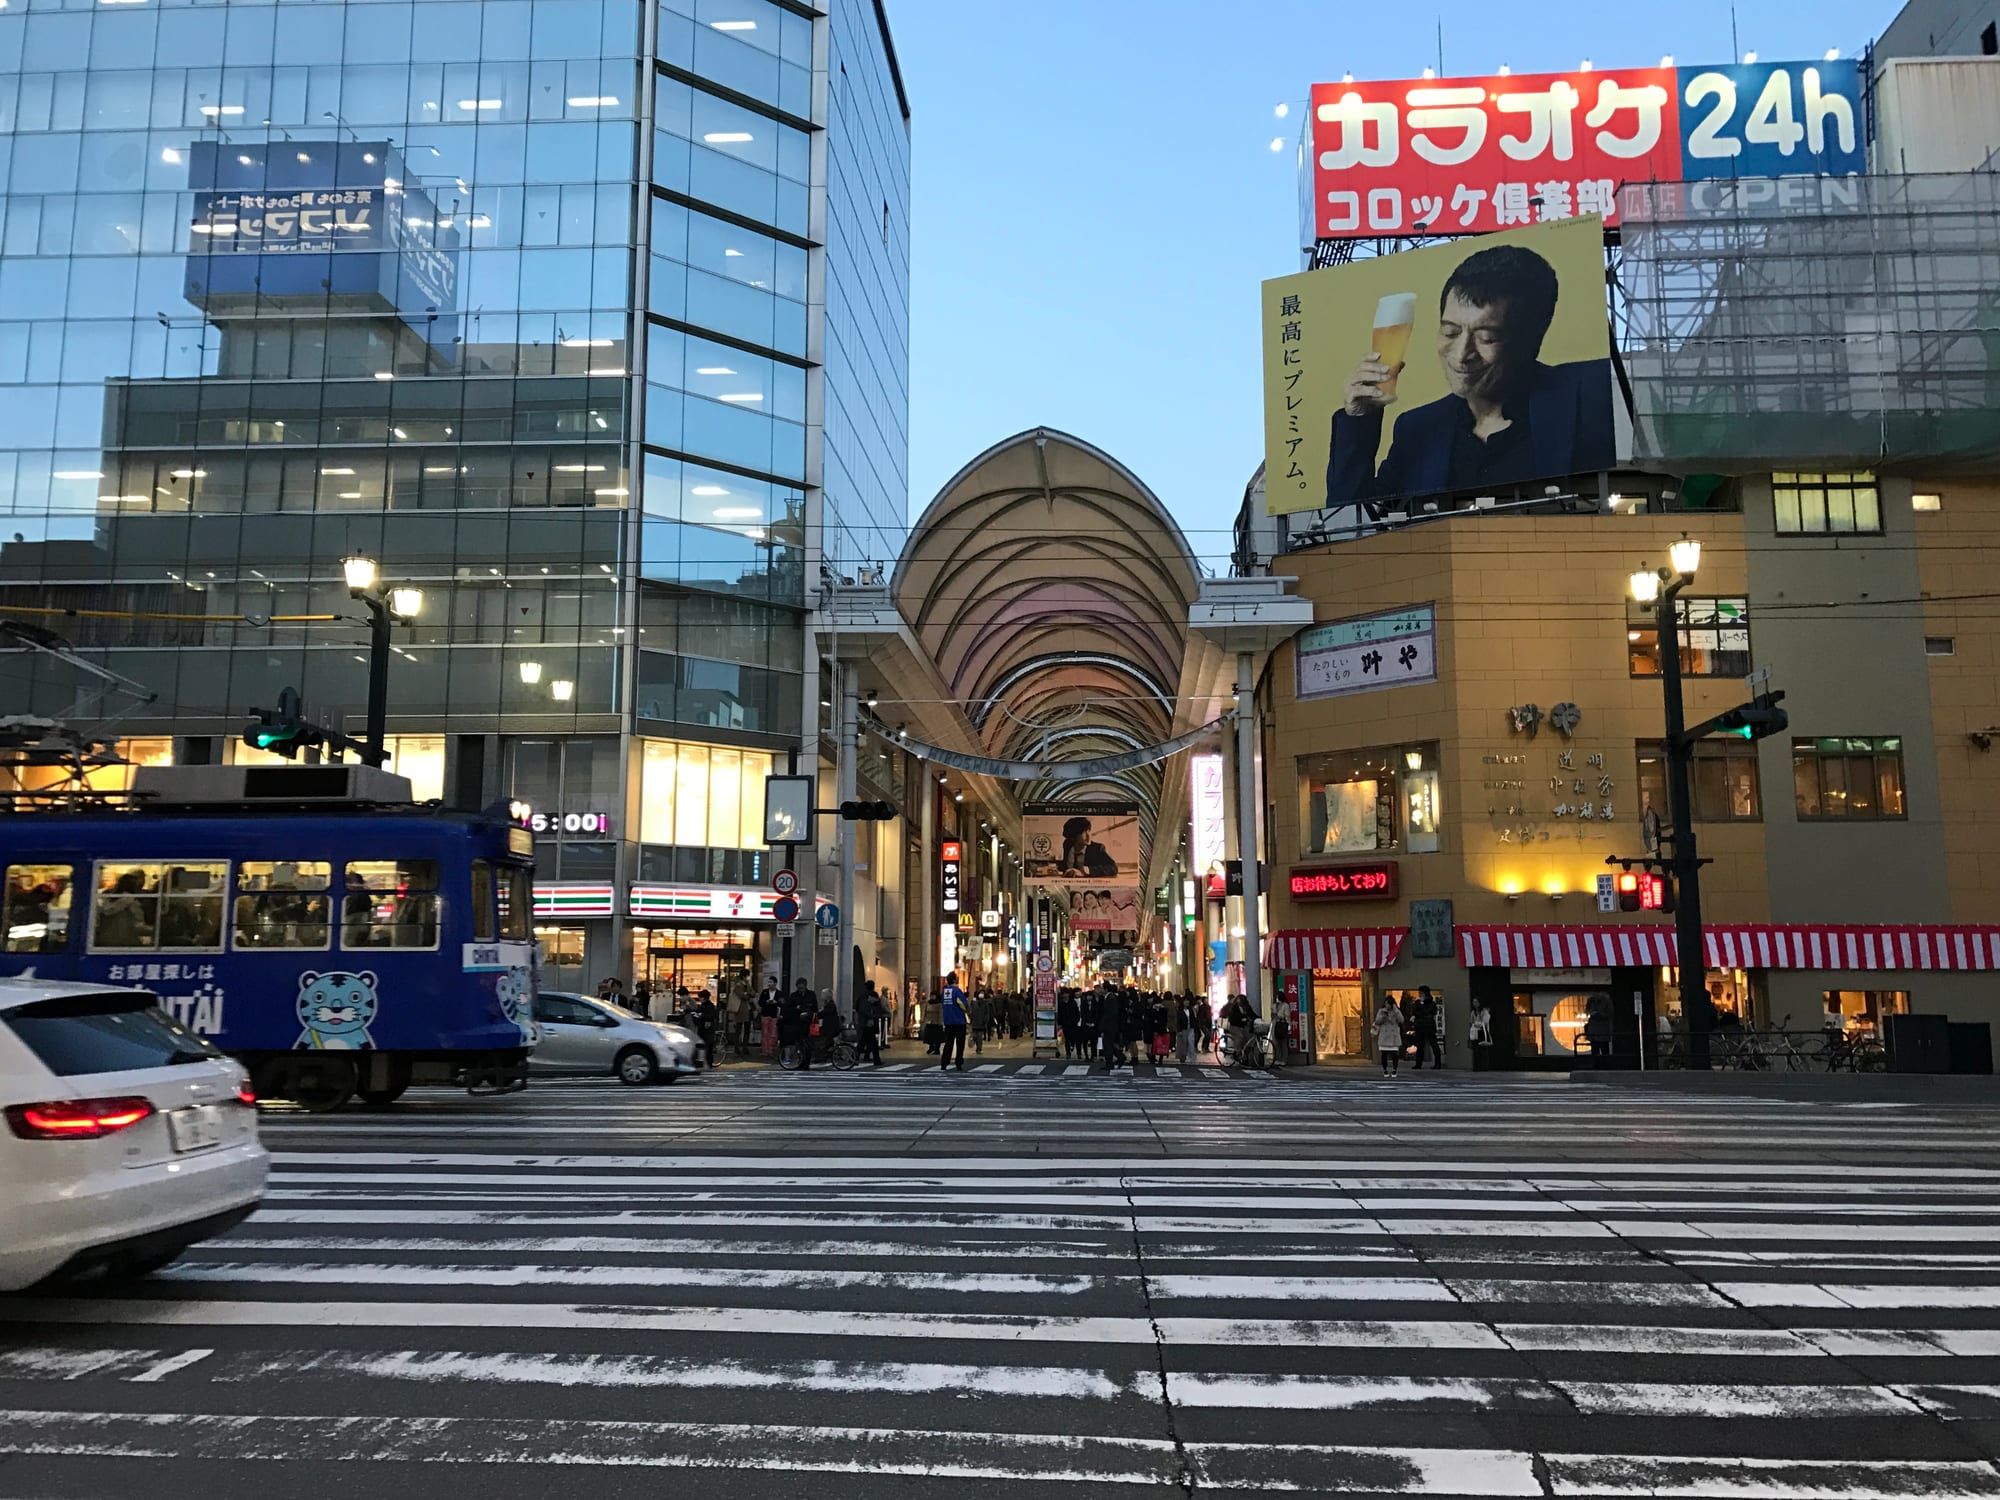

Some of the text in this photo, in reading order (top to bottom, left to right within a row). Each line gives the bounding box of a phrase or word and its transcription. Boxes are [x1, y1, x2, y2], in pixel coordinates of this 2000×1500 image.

[1317, 80, 1668, 170] カラオケ
[1685, 68, 1855, 159] 24h
[1327, 179, 1615, 231] コロッケ倶楽部
[1691, 171, 1859, 216] OPEN
[1279, 294, 1307, 490] 最高にプレミアム。
[1312, 659, 1350, 673] たのしい
[778, 876, 793, 889] 20
[108, 964, 215, 980] お部屋探しは
